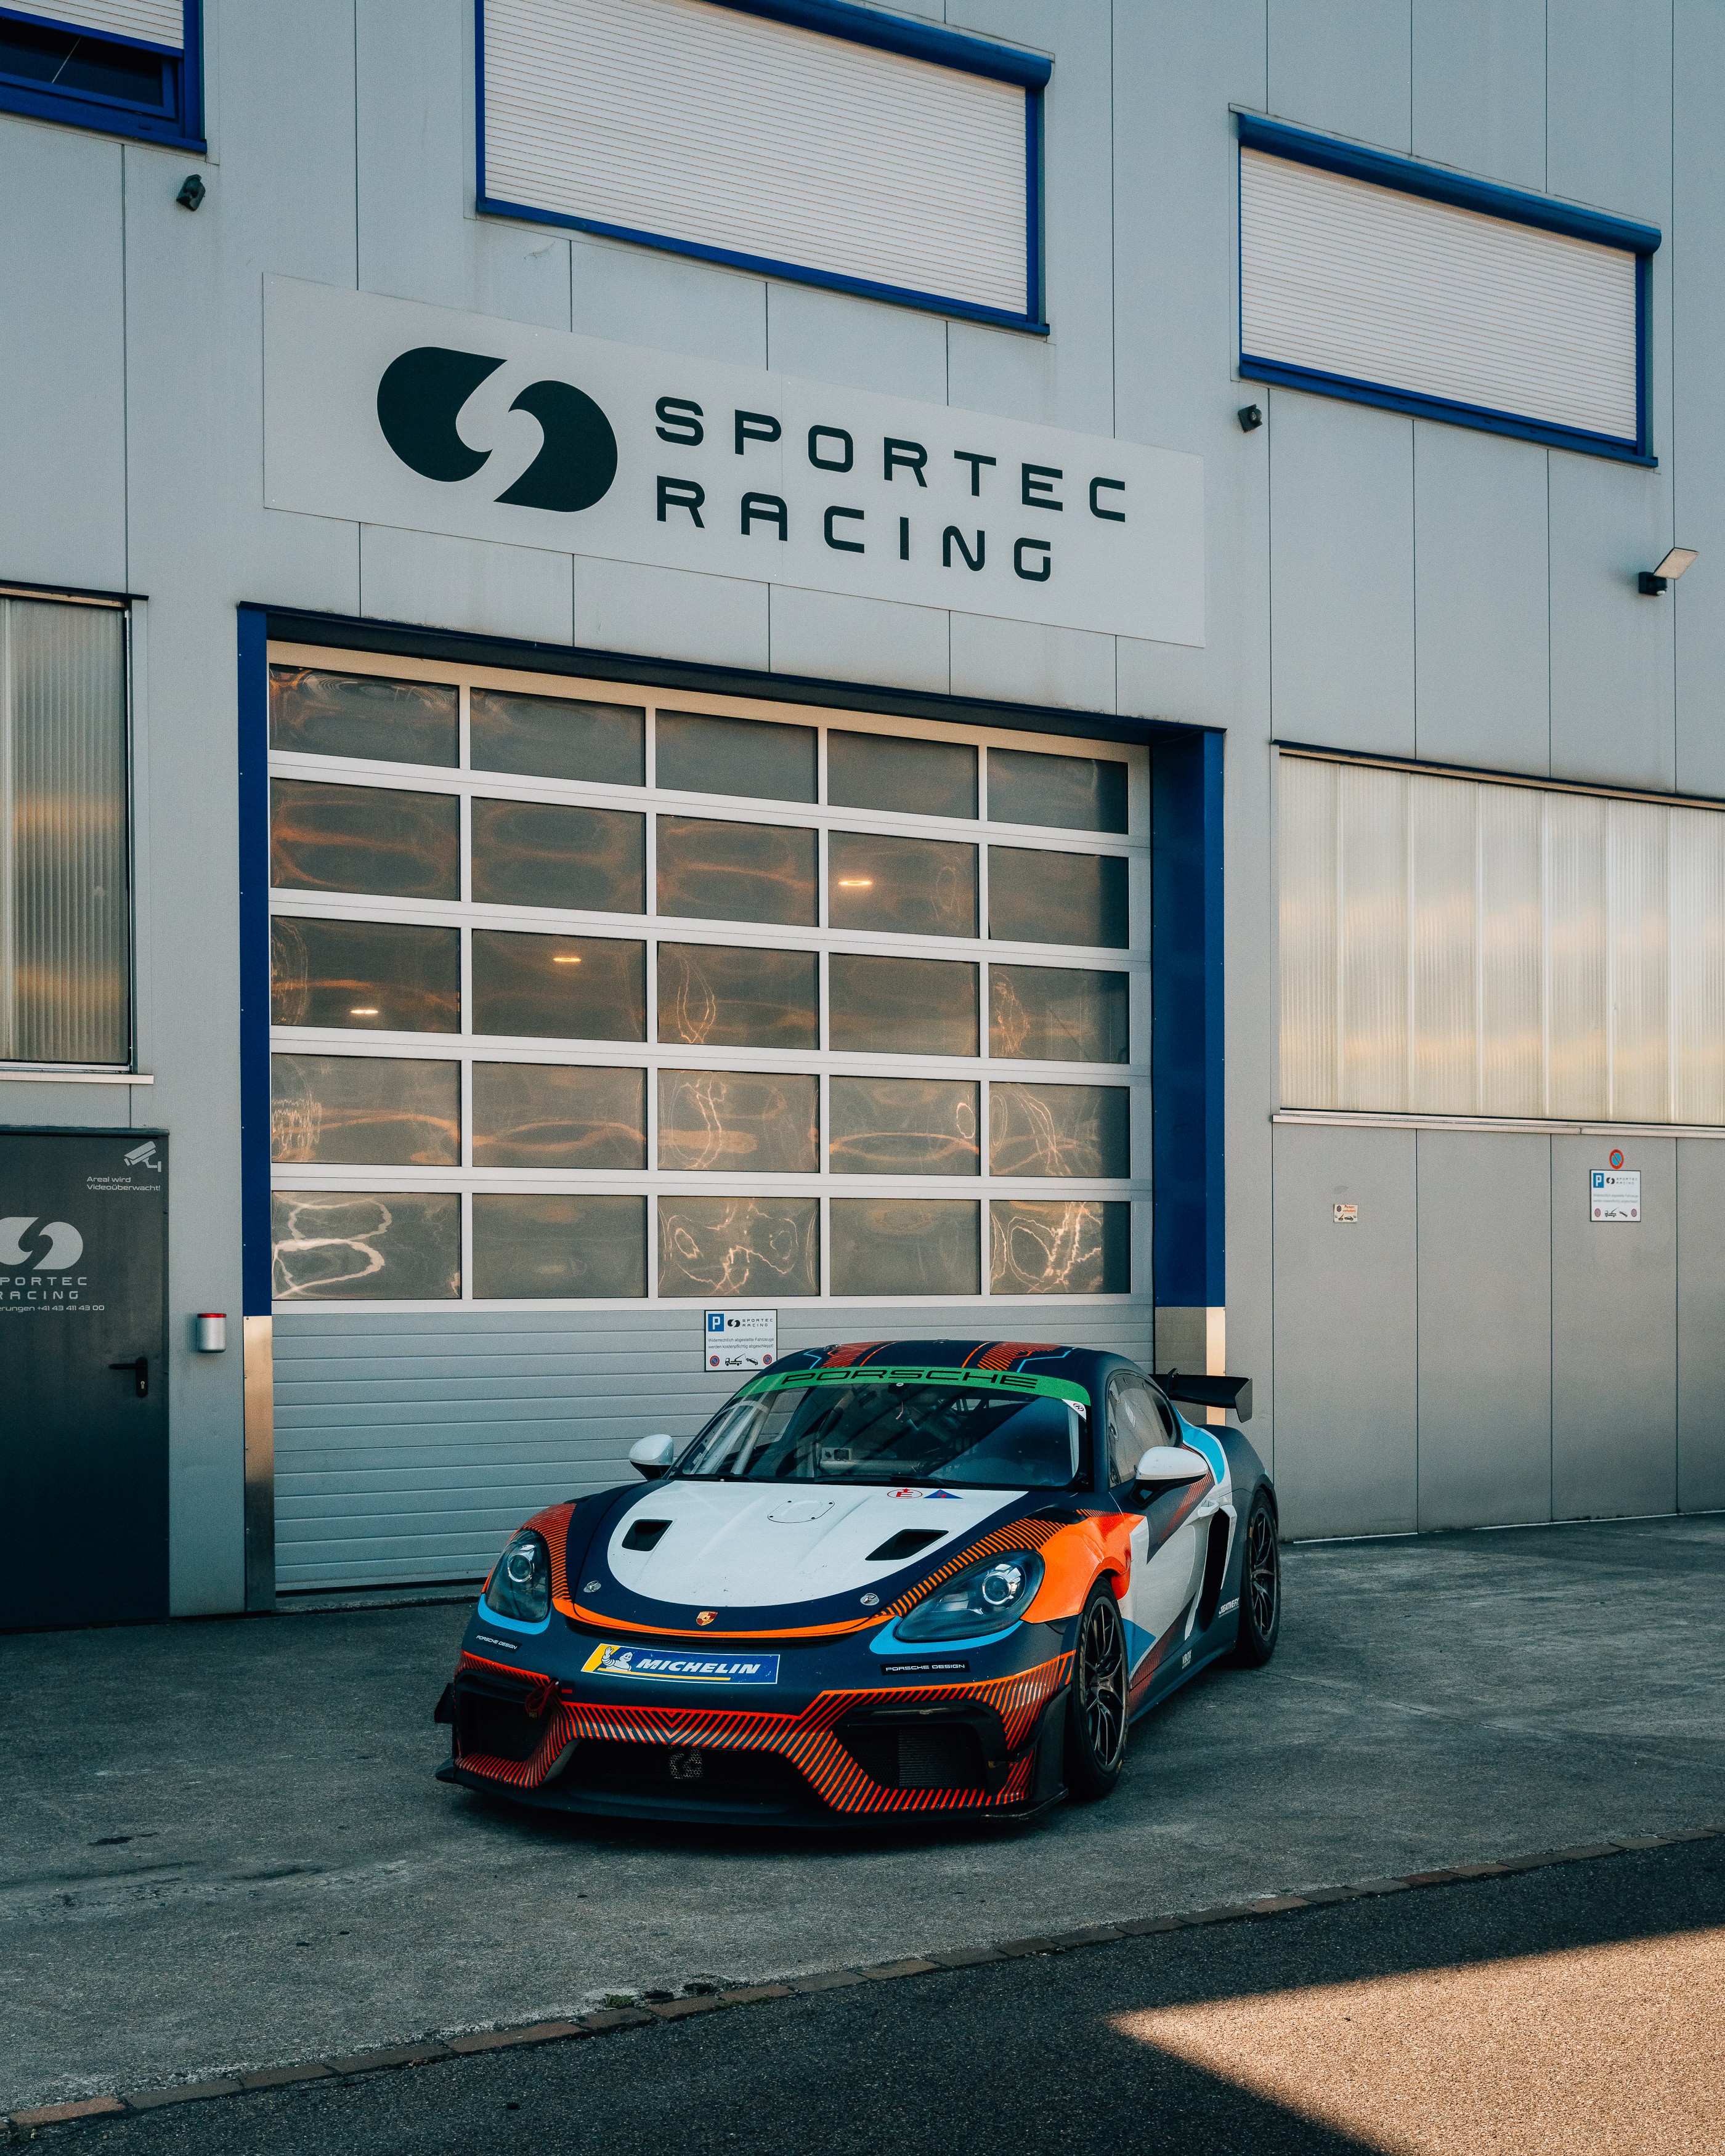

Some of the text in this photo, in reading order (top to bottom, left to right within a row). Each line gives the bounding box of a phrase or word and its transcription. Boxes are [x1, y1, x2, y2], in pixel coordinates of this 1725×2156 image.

[655, 396, 1126, 522] SPORTEC
[657, 475, 1051, 582] RACING
[1596, 1175, 1602, 1186] P
[712, 1316, 721, 1330] P
[780, 1369, 1039, 1389] PORSCHE
[476, 1635, 518, 1649] PORSCHE DESIGN
[635, 1658, 761, 1674] MICHELIN
